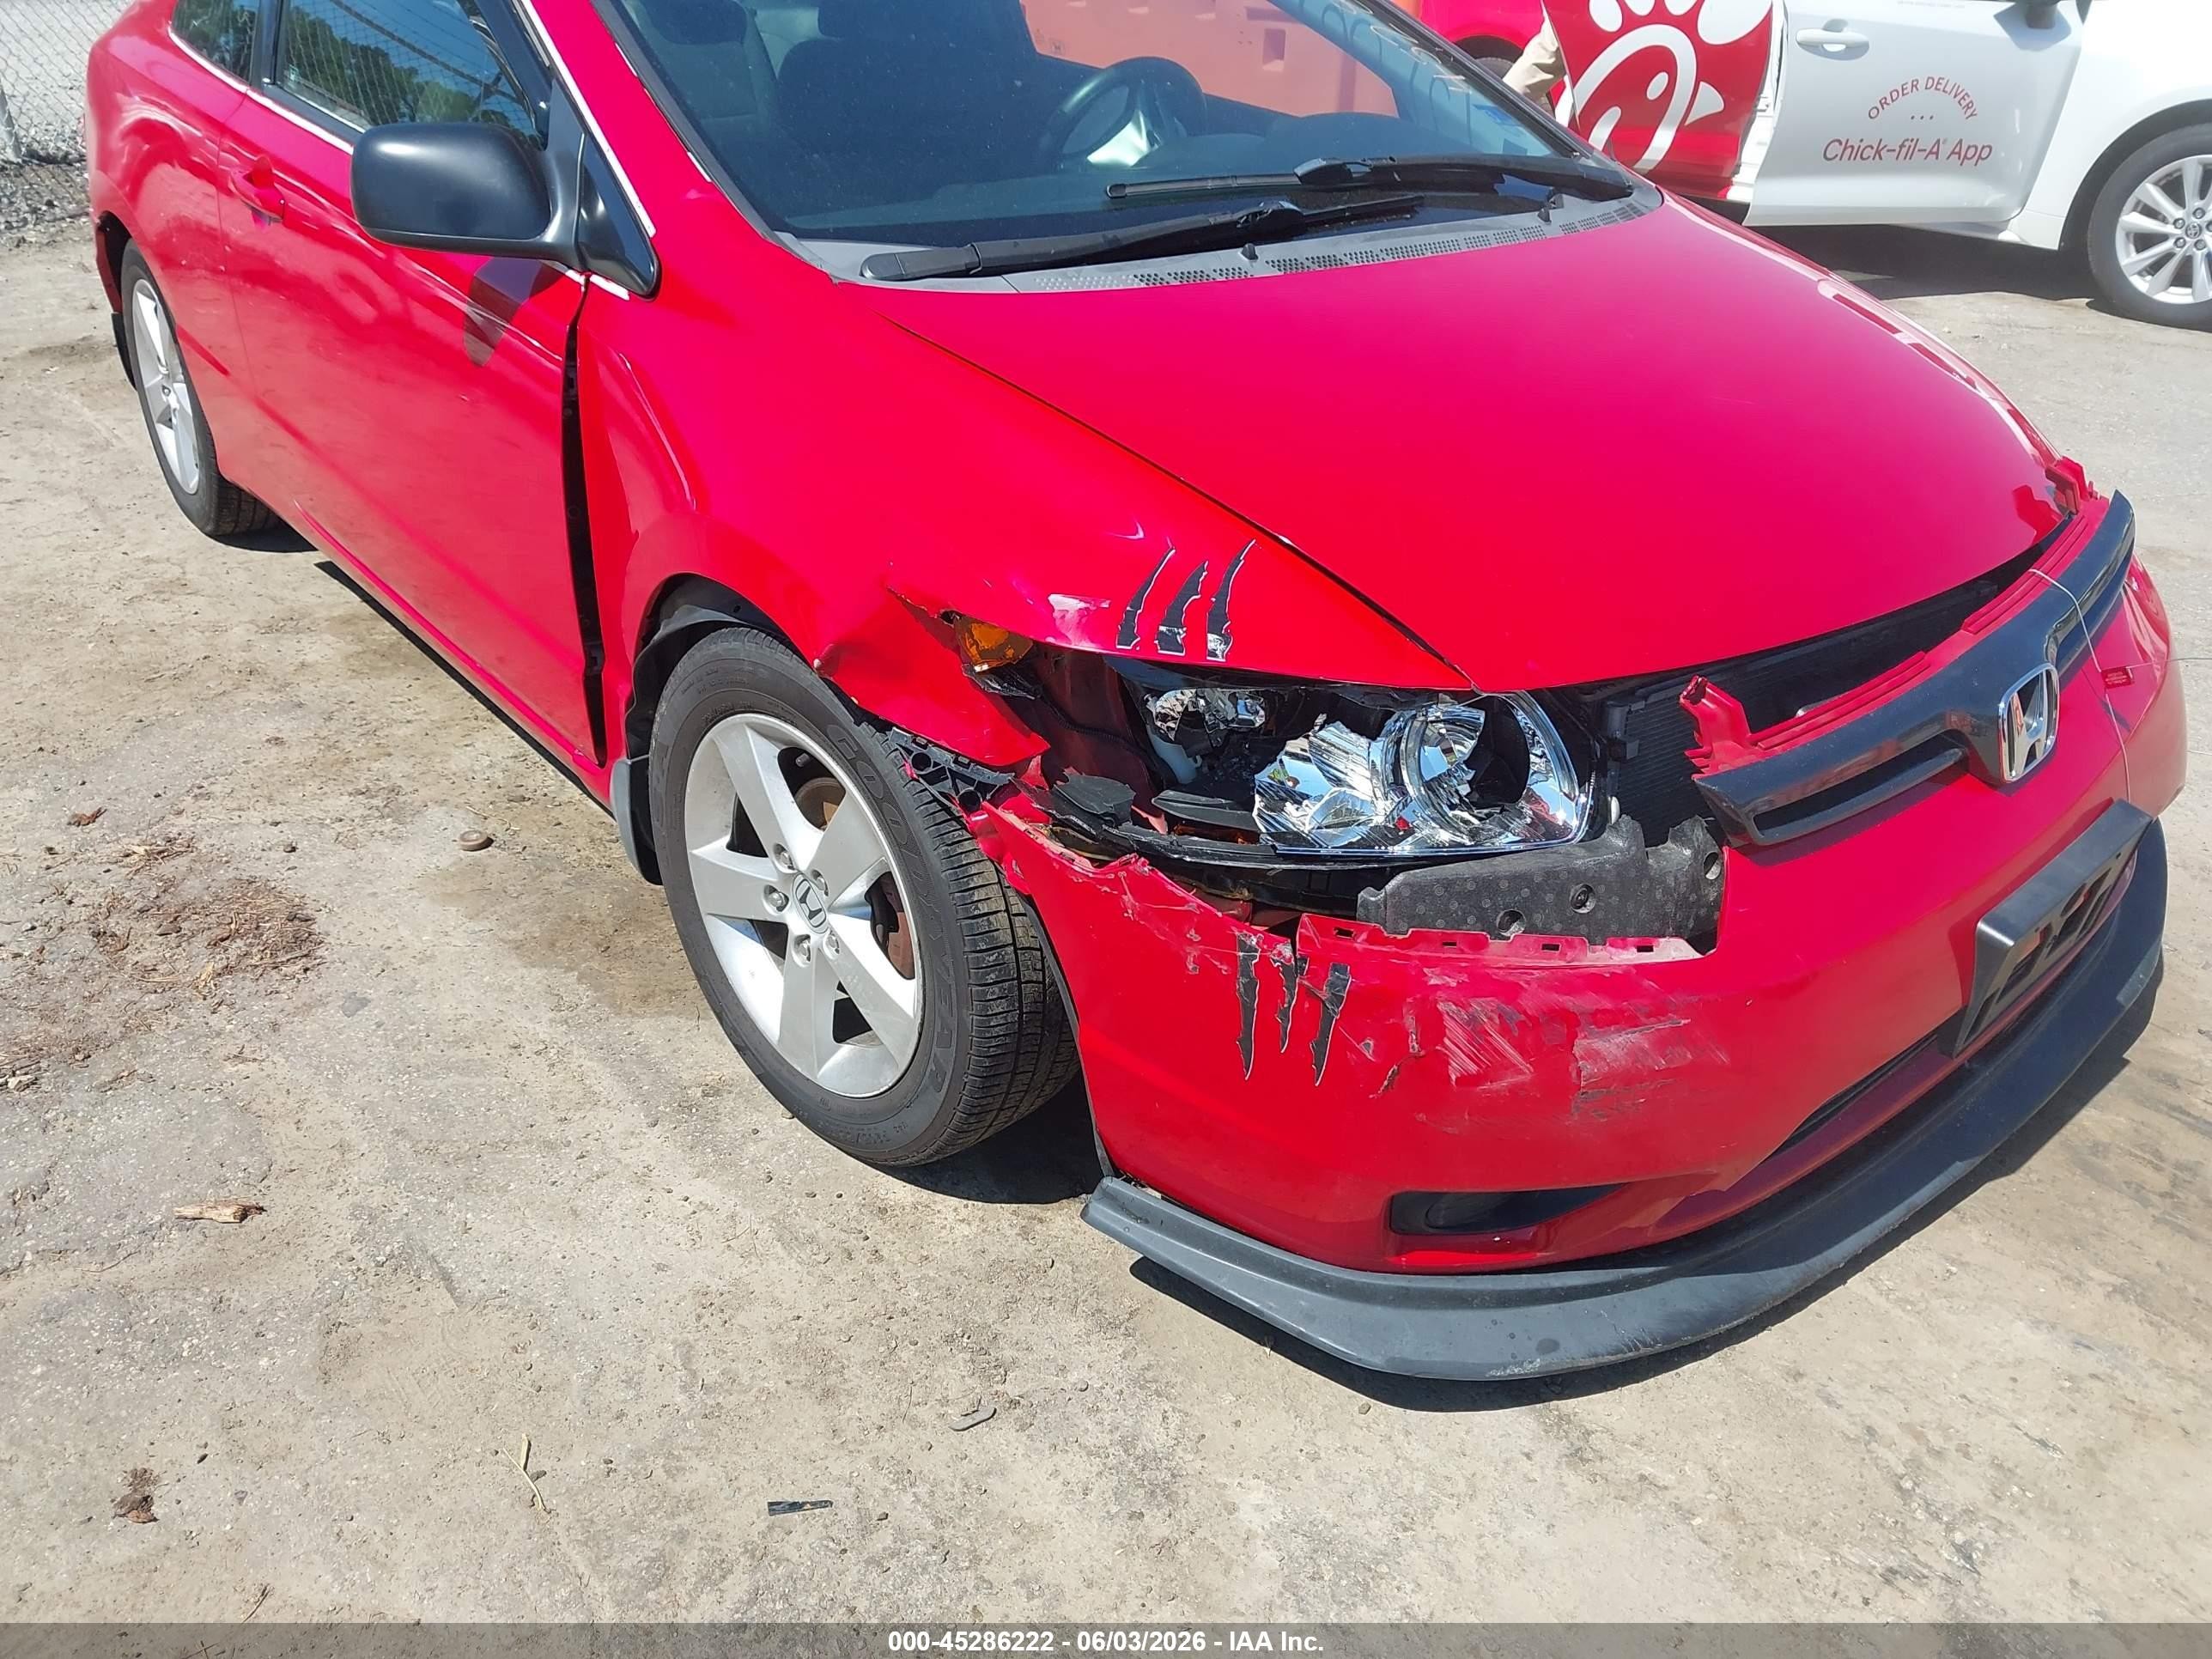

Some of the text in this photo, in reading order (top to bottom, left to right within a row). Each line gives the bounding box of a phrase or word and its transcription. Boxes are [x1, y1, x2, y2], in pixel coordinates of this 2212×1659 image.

[1868, 76, 1978, 119] ORDER DELIVERY
[1946, 137, 1993, 167] App
[826, 723, 955, 1096] GOODYEAR
